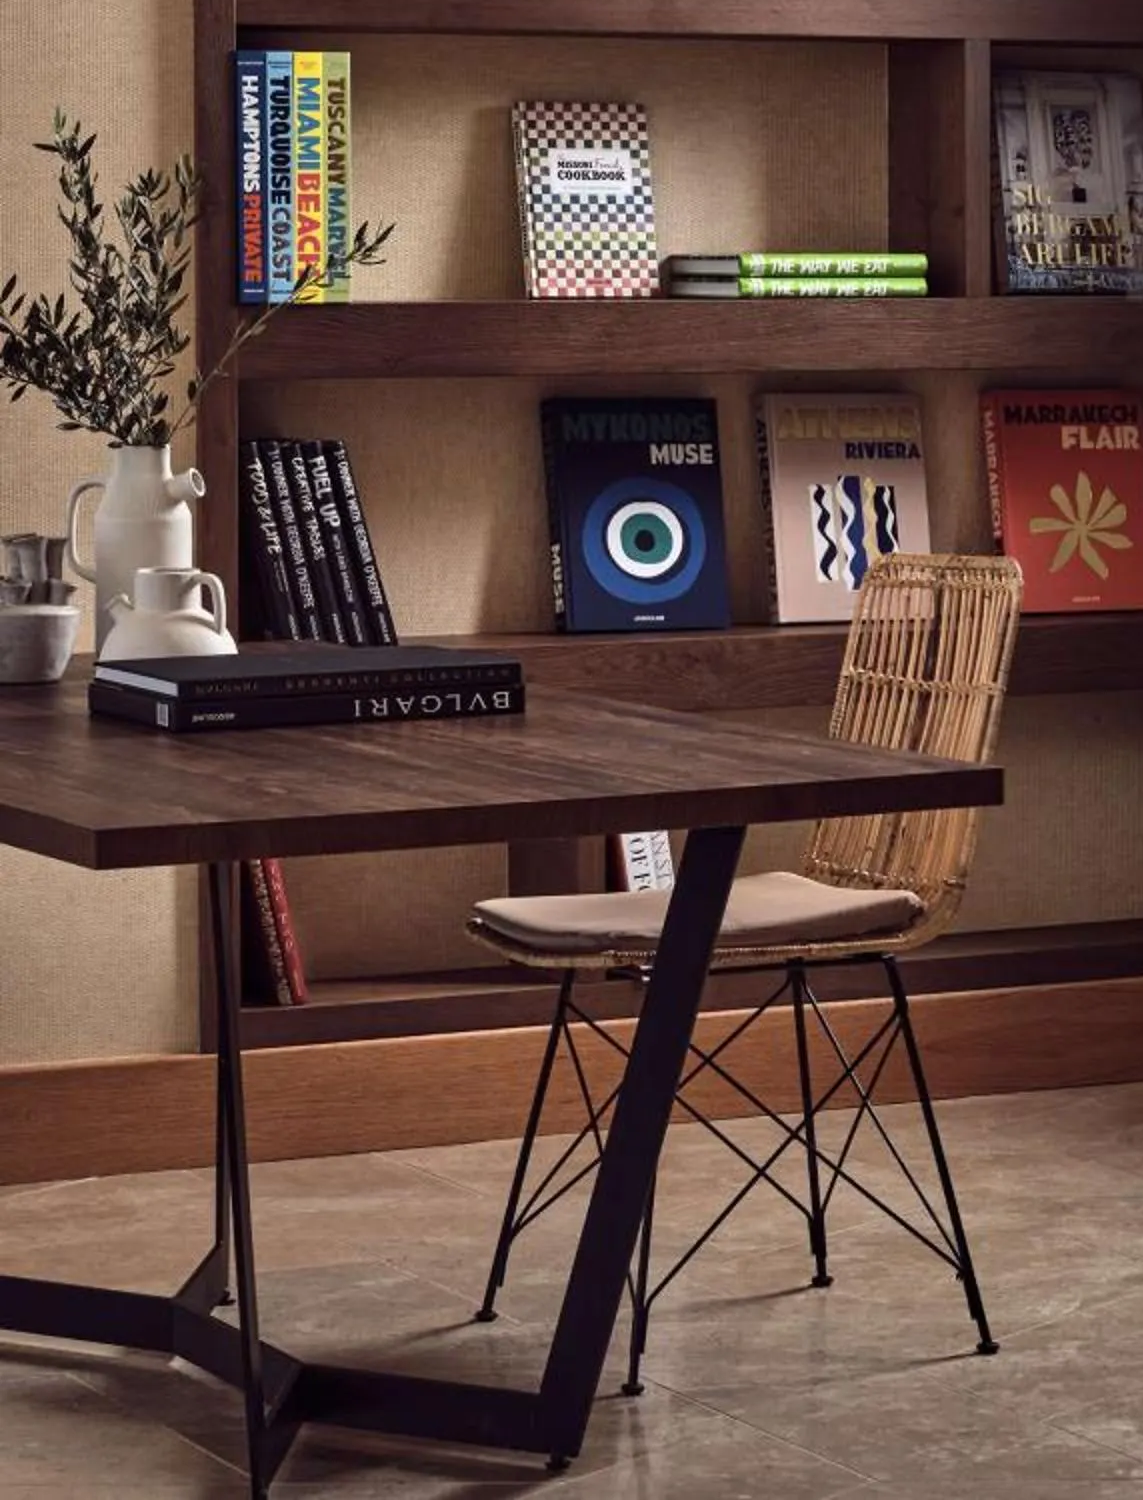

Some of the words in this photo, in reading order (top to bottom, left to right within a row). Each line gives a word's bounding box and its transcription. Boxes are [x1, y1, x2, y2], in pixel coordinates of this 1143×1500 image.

[241, 75, 261, 194] HAMPTONS
[269, 75, 291, 204] TURQUOISE
[297, 77, 321, 170] MIAMI
[327, 77, 346, 183] TUSCANY
[557, 170, 626, 181] COOKBOOK
[243, 194, 262, 283] PRIVATE
[271, 207, 291, 282] COAST
[771, 259, 795, 274] THE
[562, 412, 711, 442] MYKONOS
[1003, 404, 1139, 426] MARRAKECH
[1061, 425, 1141, 450] FLAIR
[650, 444, 714, 465] MUSE
[845, 442, 921, 460] RIVIERA
[248, 457, 269, 504] FOOD
[260, 522, 282, 555] LIFE
[291, 457, 315, 512] CREATIVE
[308, 456, 332, 500] FUEL
[320, 503, 341, 528] UP
[551, 543, 565, 614] MUSE
[353, 690, 511, 719] BVLGARI
